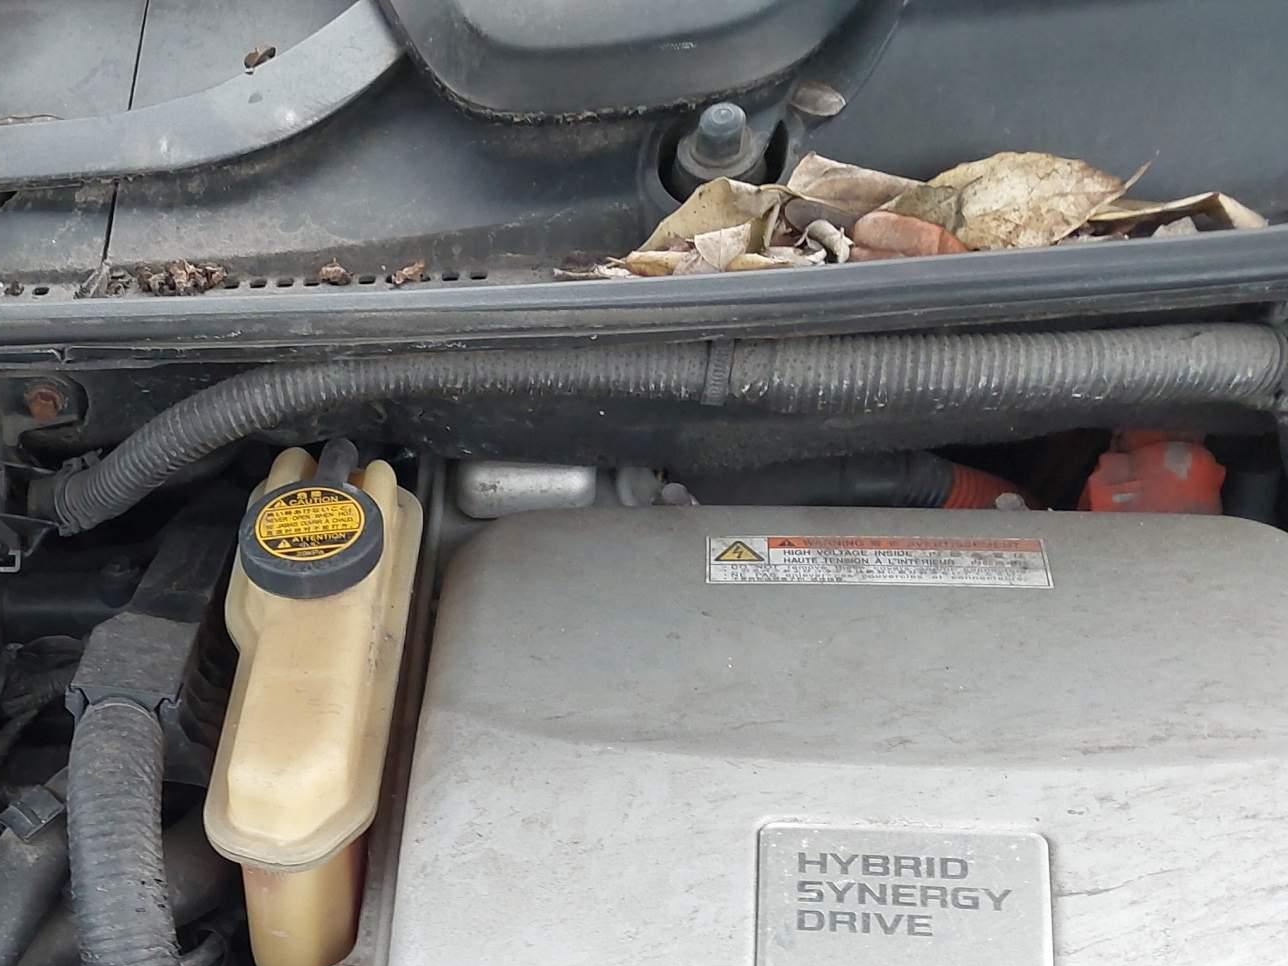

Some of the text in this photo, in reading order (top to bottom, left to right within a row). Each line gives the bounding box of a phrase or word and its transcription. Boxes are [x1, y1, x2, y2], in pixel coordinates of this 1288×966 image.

[289, 496, 339, 506] CAUTION
[292, 533, 346, 542] ATTENTION
[817, 549, 869, 557] VOLTAGE
[797, 852, 969, 880] HYBRID
[796, 880, 1012, 912] SYNERGY
[796, 909, 933, 937] DRIVE
